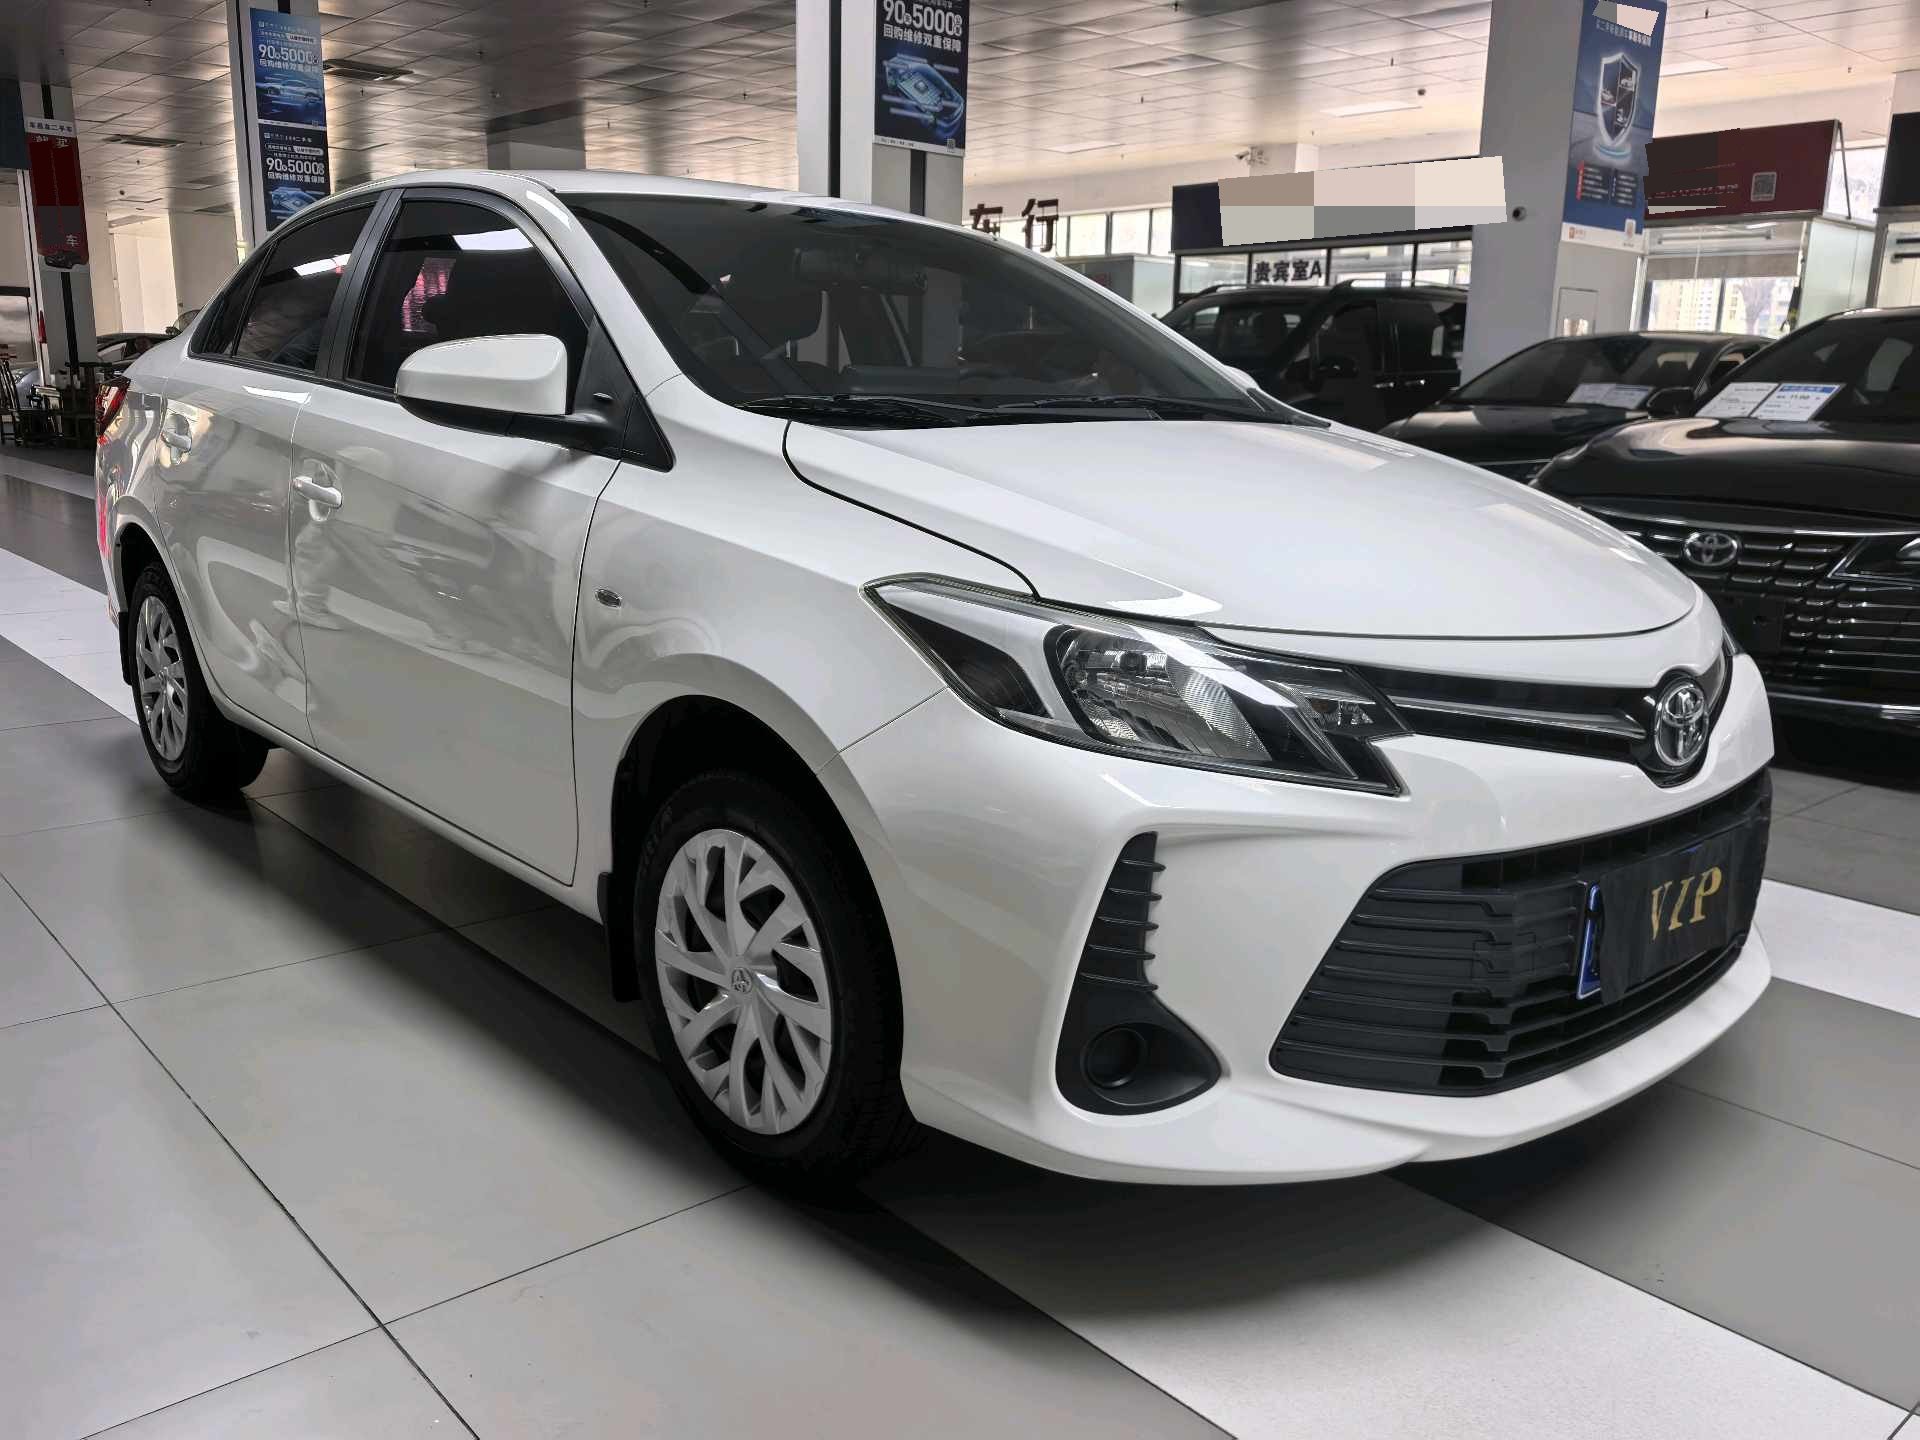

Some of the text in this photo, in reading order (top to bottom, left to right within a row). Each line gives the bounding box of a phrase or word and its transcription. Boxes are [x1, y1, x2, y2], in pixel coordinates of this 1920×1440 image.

[1254, 260, 1322, 283] 贵宾室A
[1650, 866, 1723, 940] VIP
